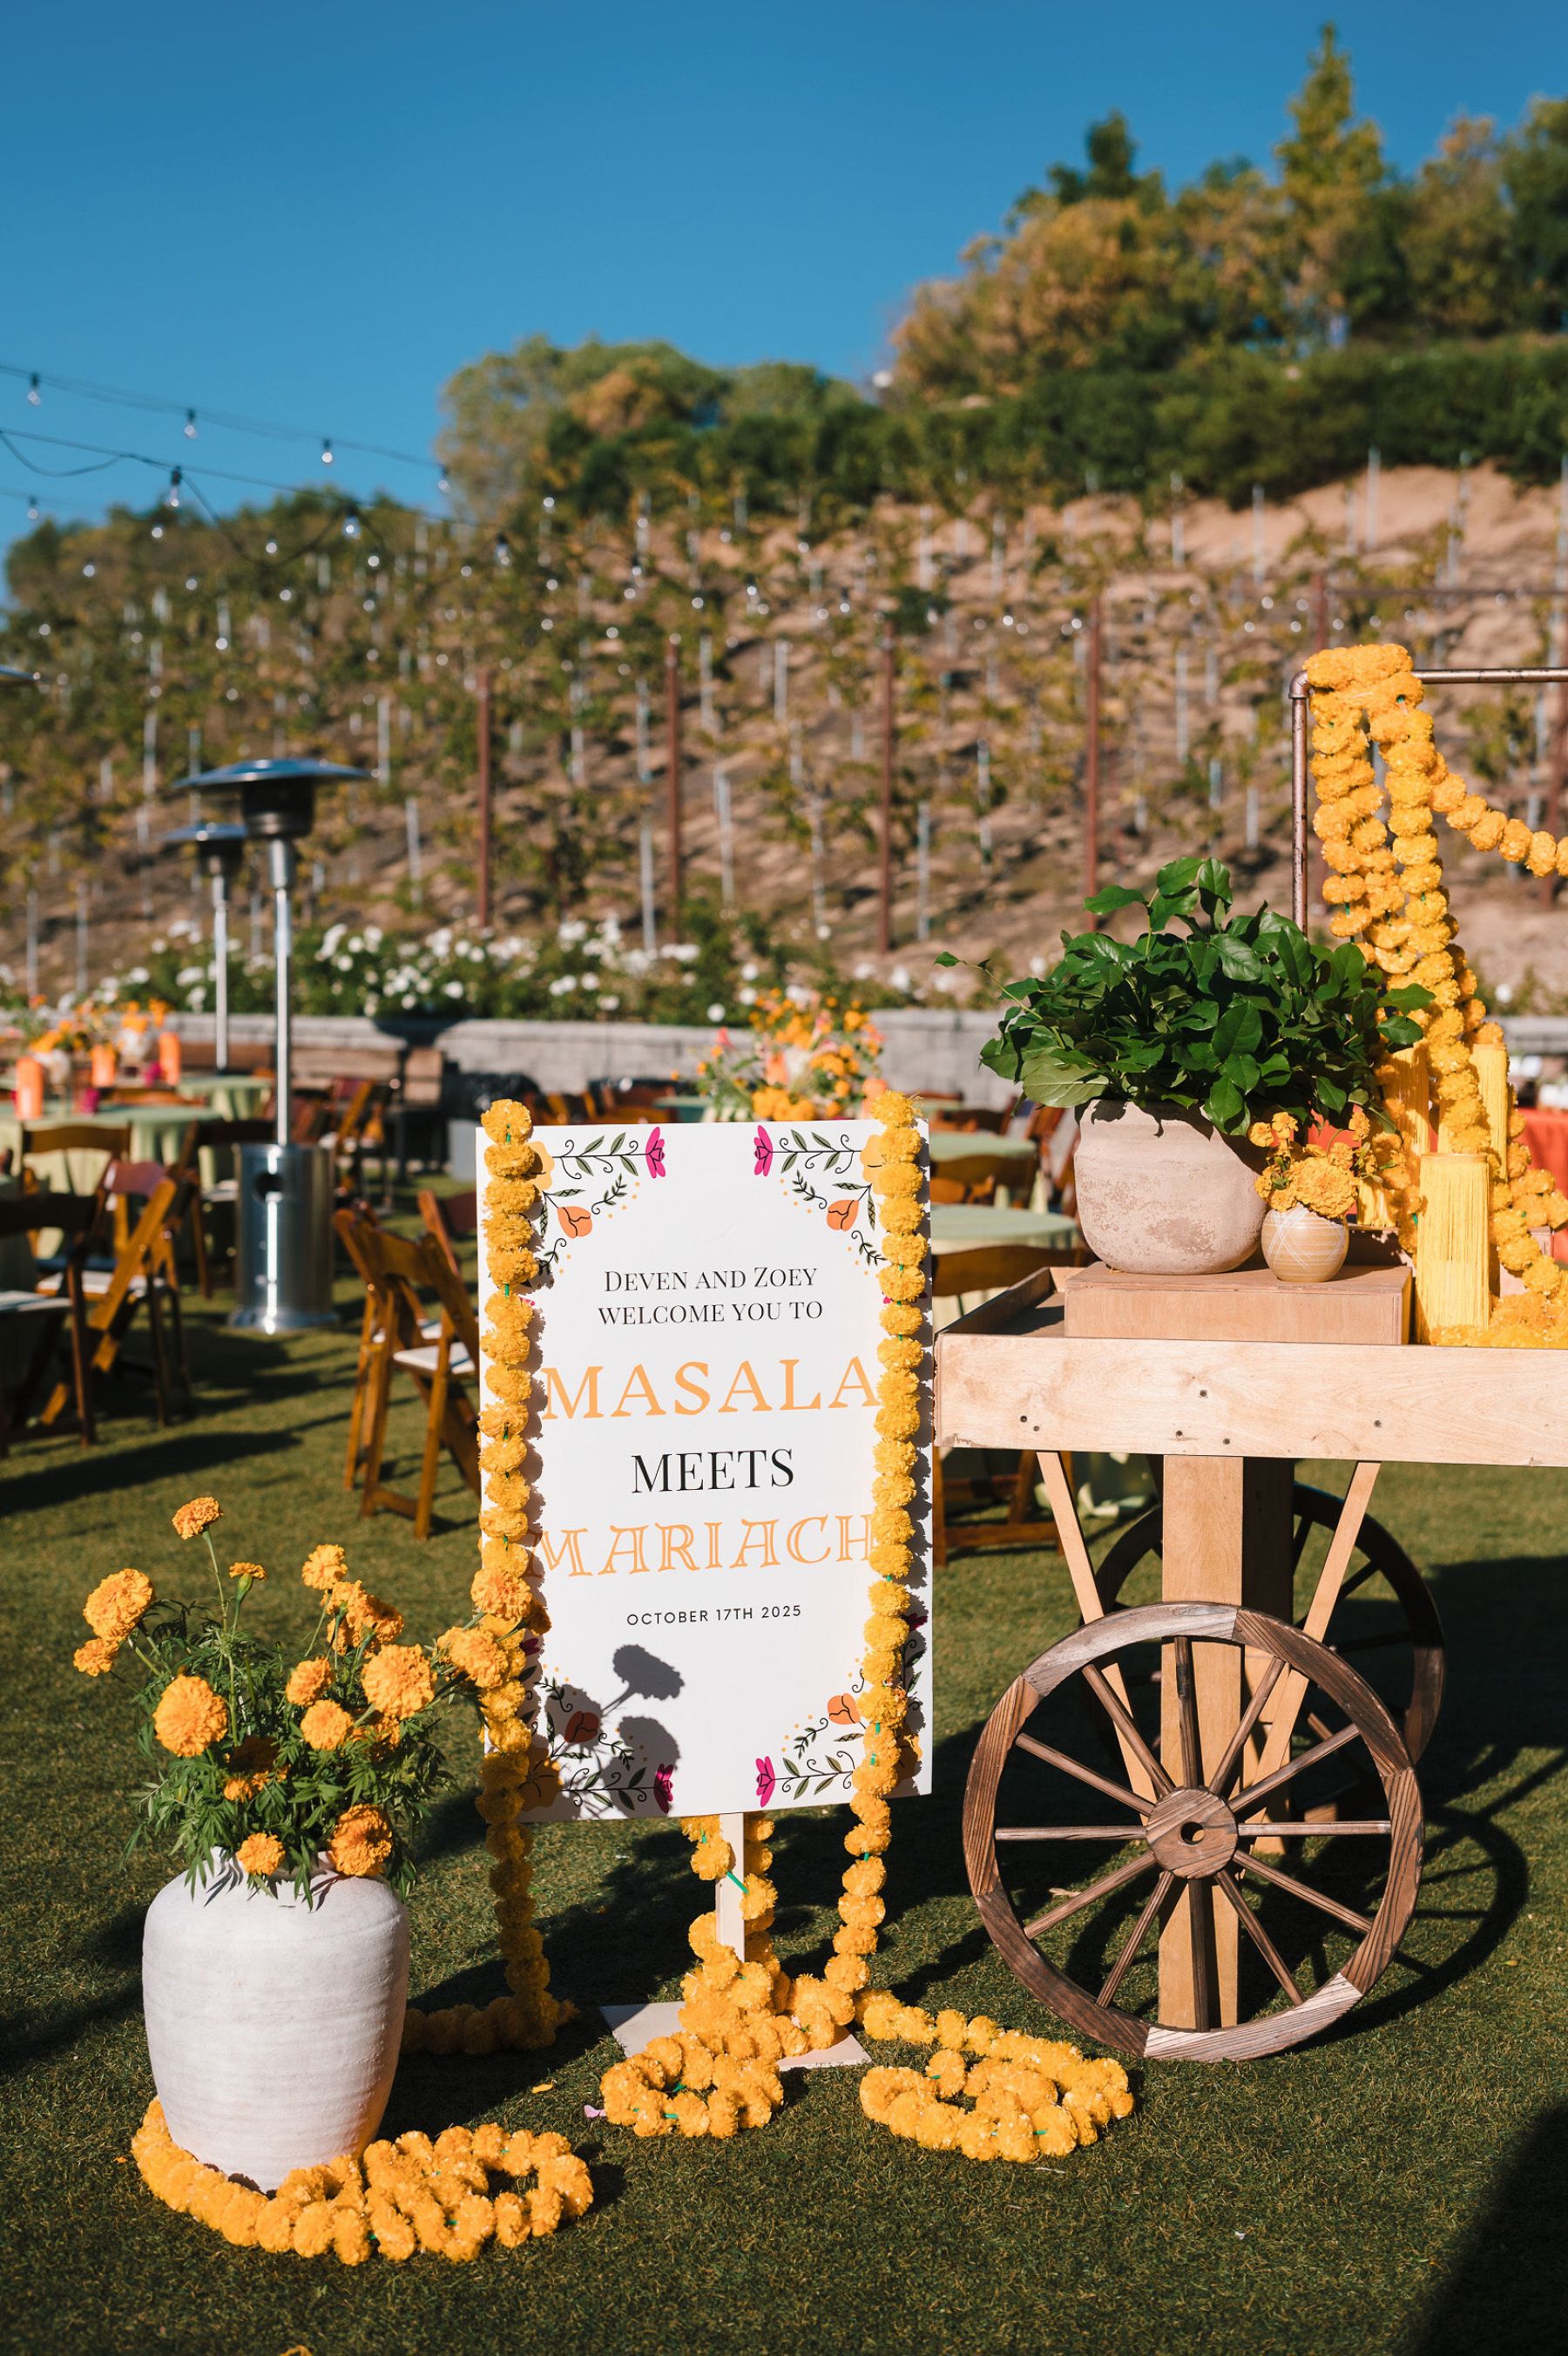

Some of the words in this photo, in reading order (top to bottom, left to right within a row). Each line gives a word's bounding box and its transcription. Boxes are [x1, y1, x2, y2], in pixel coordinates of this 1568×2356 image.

[605, 1270, 688, 1292] DEVEN
[695, 1270, 747, 1290] AND
[754, 1267, 817, 1288] ZOEY
[598, 1303, 725, 1325] WELCOME
[731, 1303, 781, 1322] YOU
[788, 1301, 823, 1319] TO
[541, 1356, 882, 1420] MASALA
[631, 1448, 794, 1493] MEETS
[527, 1513, 873, 1579] MARIACH
[626, 1609, 708, 1626] OCTOBER
[716, 1607, 753, 1621] 17TH
[760, 1604, 801, 1619] 2025
